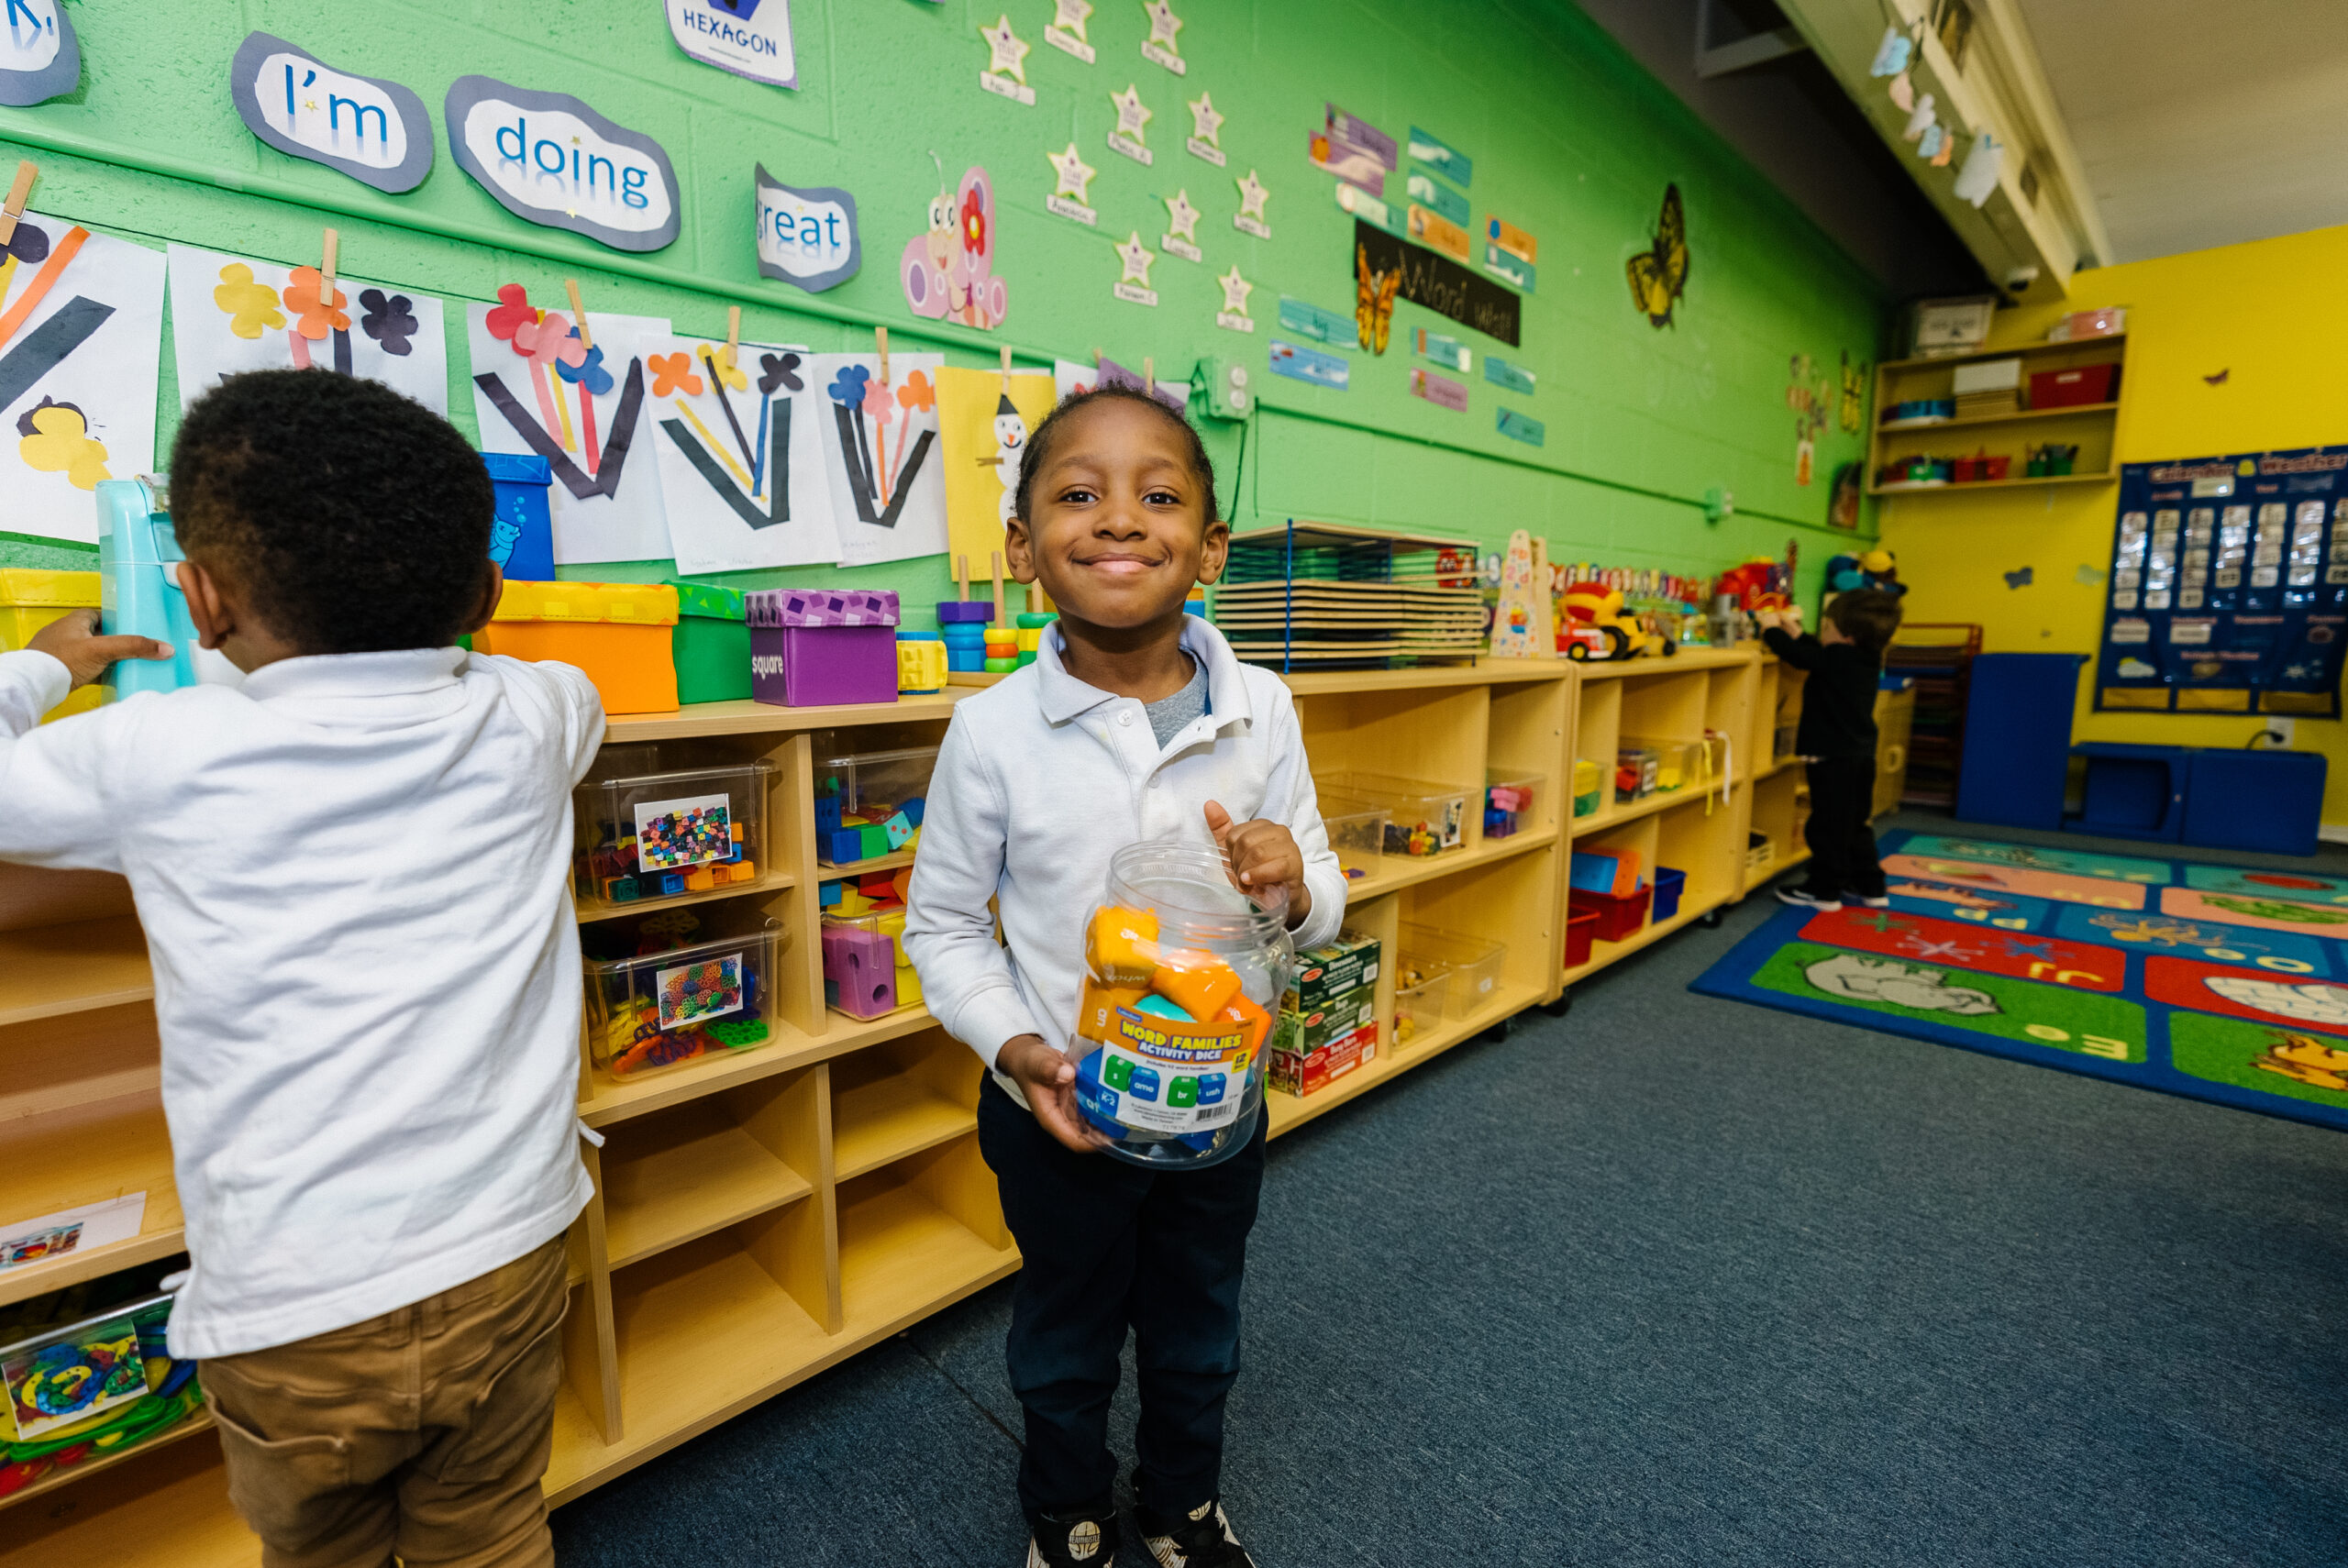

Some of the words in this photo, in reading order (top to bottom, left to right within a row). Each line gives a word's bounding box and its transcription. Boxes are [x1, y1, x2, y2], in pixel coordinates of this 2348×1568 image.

[683, 8, 777, 56] HEXAGON
[283, 64, 390, 142] I'm
[495, 116, 649, 210] doing
[752, 655, 783, 680] square
[1122, 1021, 1168, 1046] WORD
[1171, 1034, 1243, 1050] FAMILIES
[1139, 1041, 1192, 1060] ACTIVITY
[1195, 1049, 1223, 1061] DICE
[1101, 1092, 1115, 1107] K-2
[1134, 1082, 1155, 1093] ame
[1177, 1090, 1189, 1099] br
